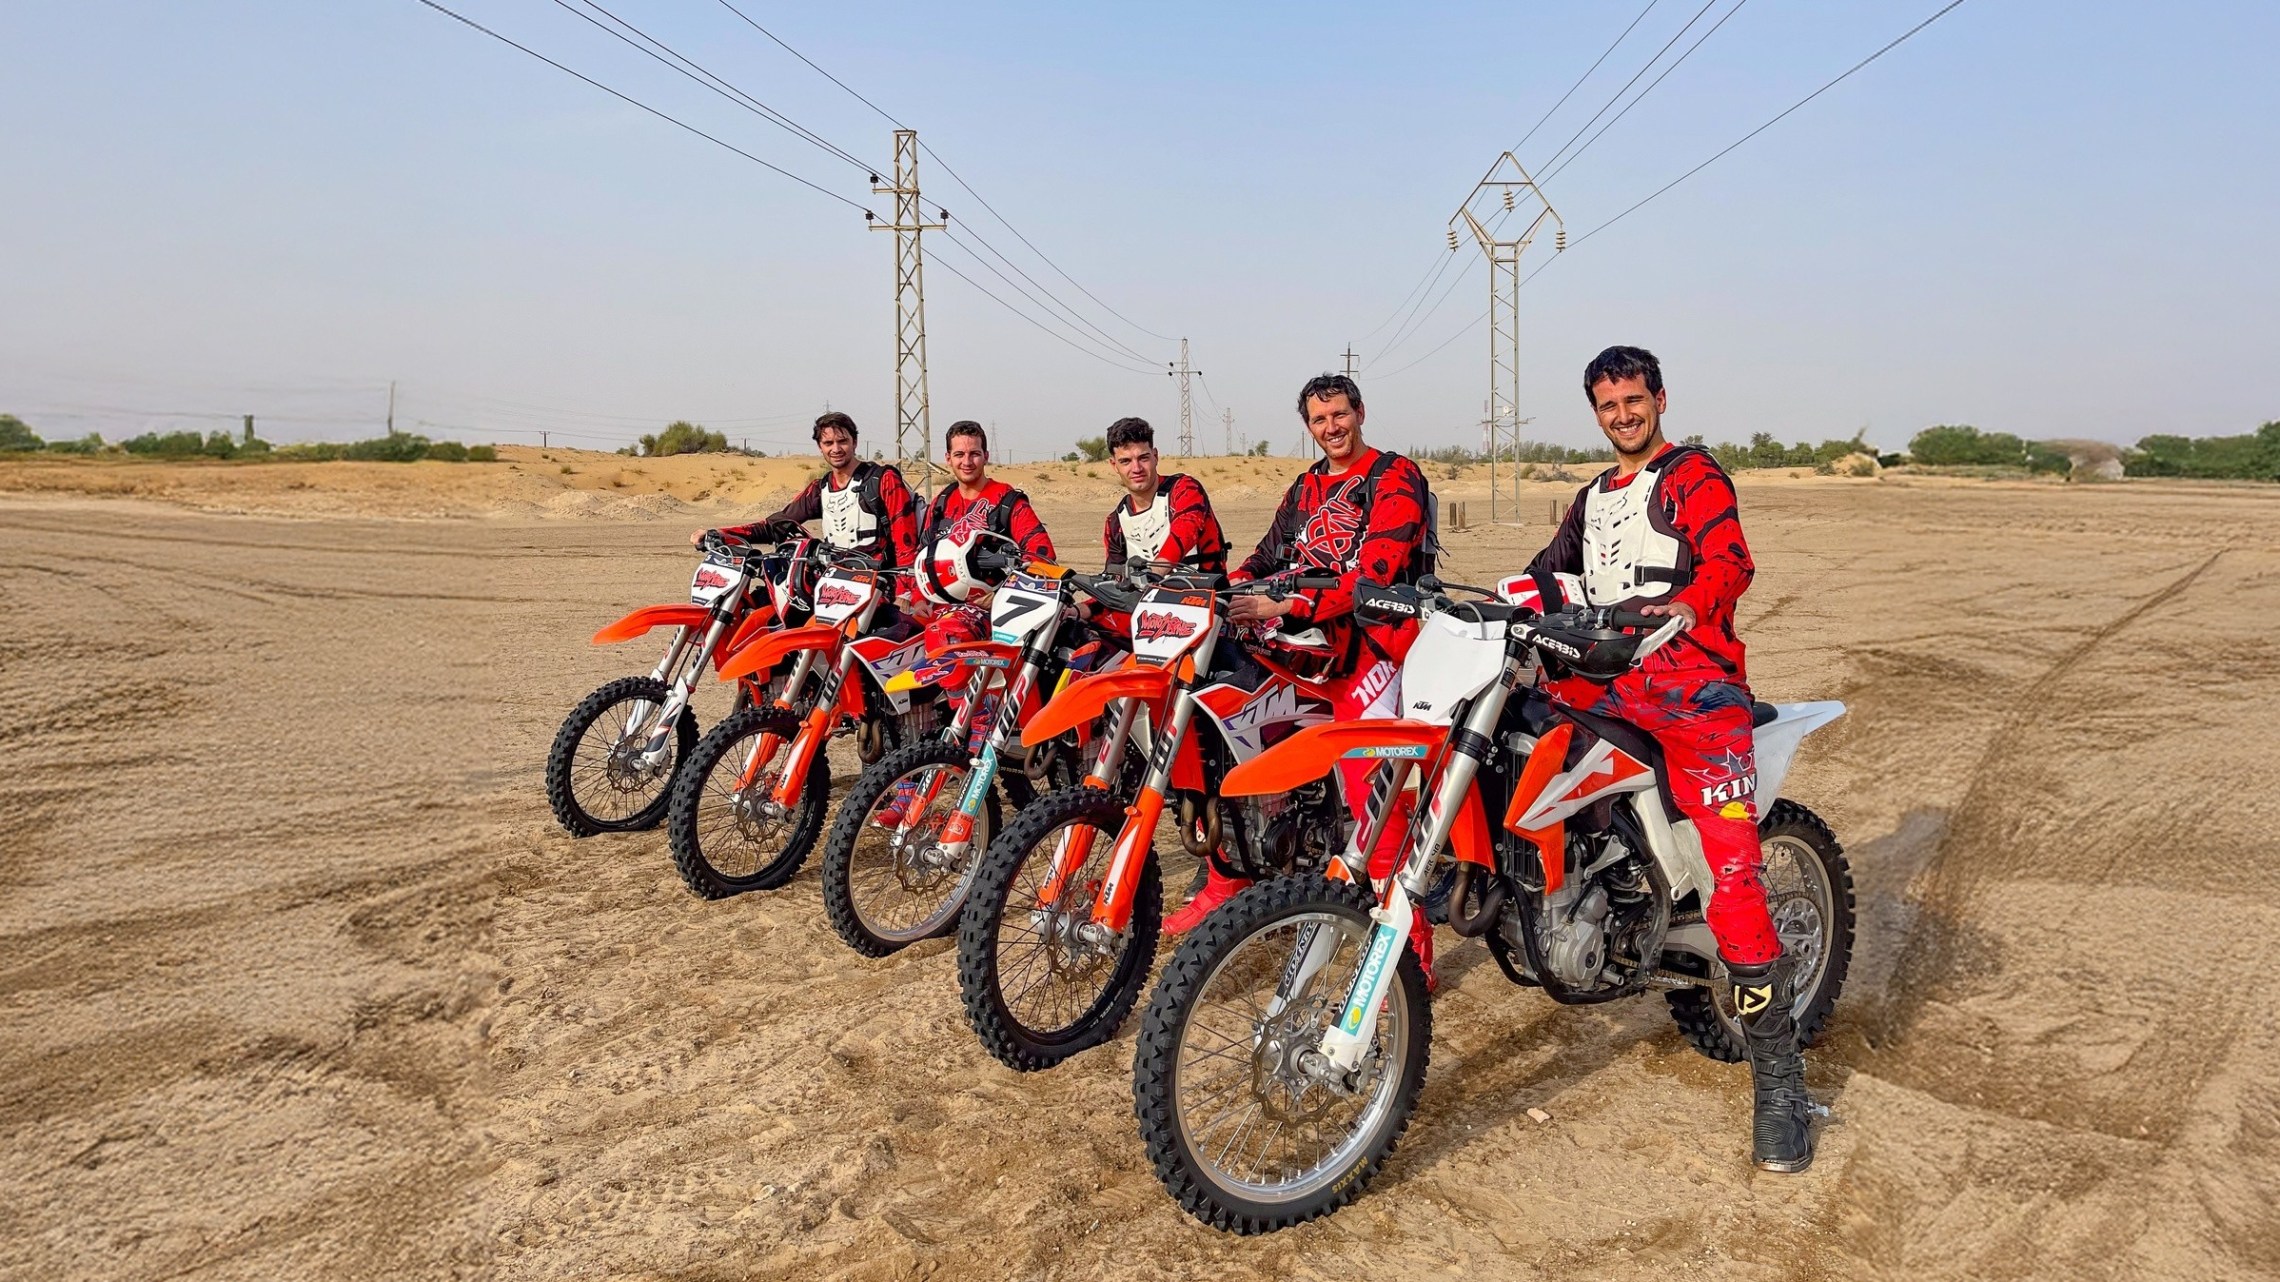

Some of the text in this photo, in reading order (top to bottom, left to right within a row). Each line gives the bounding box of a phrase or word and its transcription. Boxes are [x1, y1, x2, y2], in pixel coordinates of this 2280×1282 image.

[824, 567, 838, 578] 3
[1141, 588, 1160, 603] 4
[1180, 595, 1208, 607] KTM
[992, 595, 1047, 628] 7
[1365, 597, 1416, 615] ACERBIS
[1531, 633, 1581, 659] ACERBIS
[1412, 700, 1432, 711] KTM
[1375, 746, 1419, 757] MOTOREX
[1423, 858, 1435, 878] AER
[1103, 882, 1114, 905] KTM
[1352, 932, 1392, 1008] MOTOREX
[1331, 1155, 1368, 1194] MAXXIS
